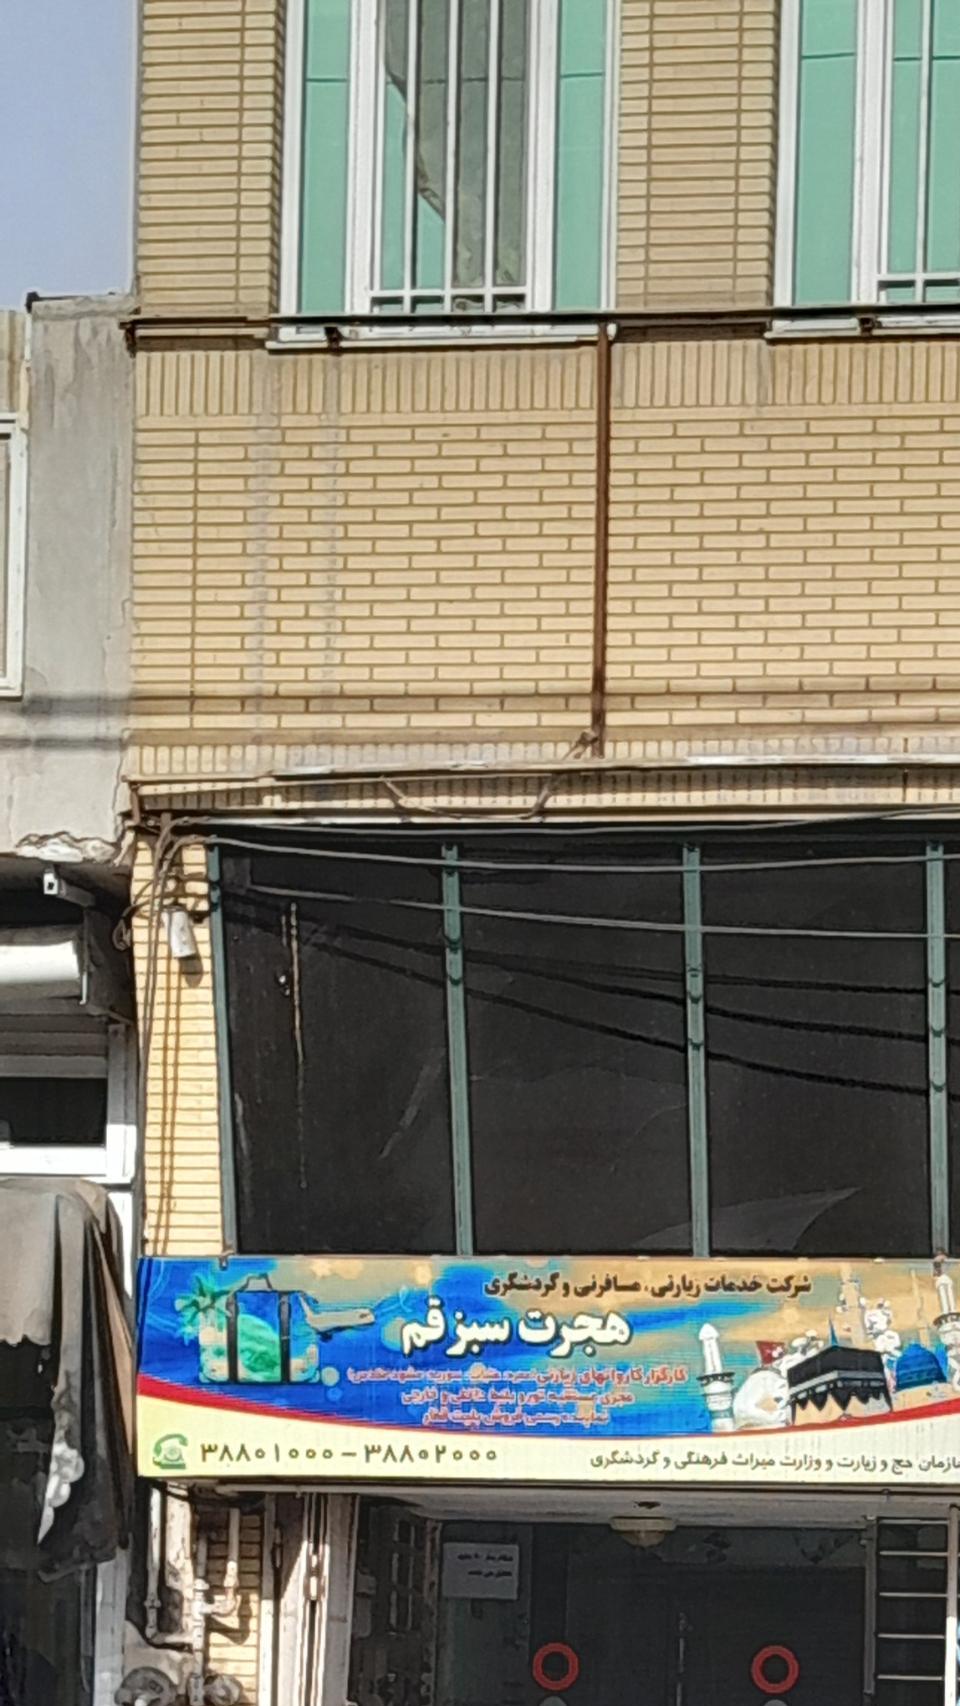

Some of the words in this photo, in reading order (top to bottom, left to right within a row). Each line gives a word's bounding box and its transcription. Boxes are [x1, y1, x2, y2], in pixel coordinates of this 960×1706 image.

[484, 1271, 560, 1297] گردشگری
[573, 1272, 641, 1298] مسافرتی
[705, 1274, 762, 1292] خدمات
[766, 1274, 812, 1298] شرکت
[400, 1296, 447, 1356] قم
[446, 1309, 510, 1358] سبز
[517, 1309, 632, 1358] هجرت
[644, 1365, 687, 1386] کارگزار
[590, 1449, 661, 1469] گردشگری
[673, 1451, 728, 1471] فرهنگی
[732, 1453, 776, 1471] میراث
[779, 1454, 822, 1472] وزارت
[836, 1455, 878, 1473] زیارت
[891, 1457, 913, 1475] حج
